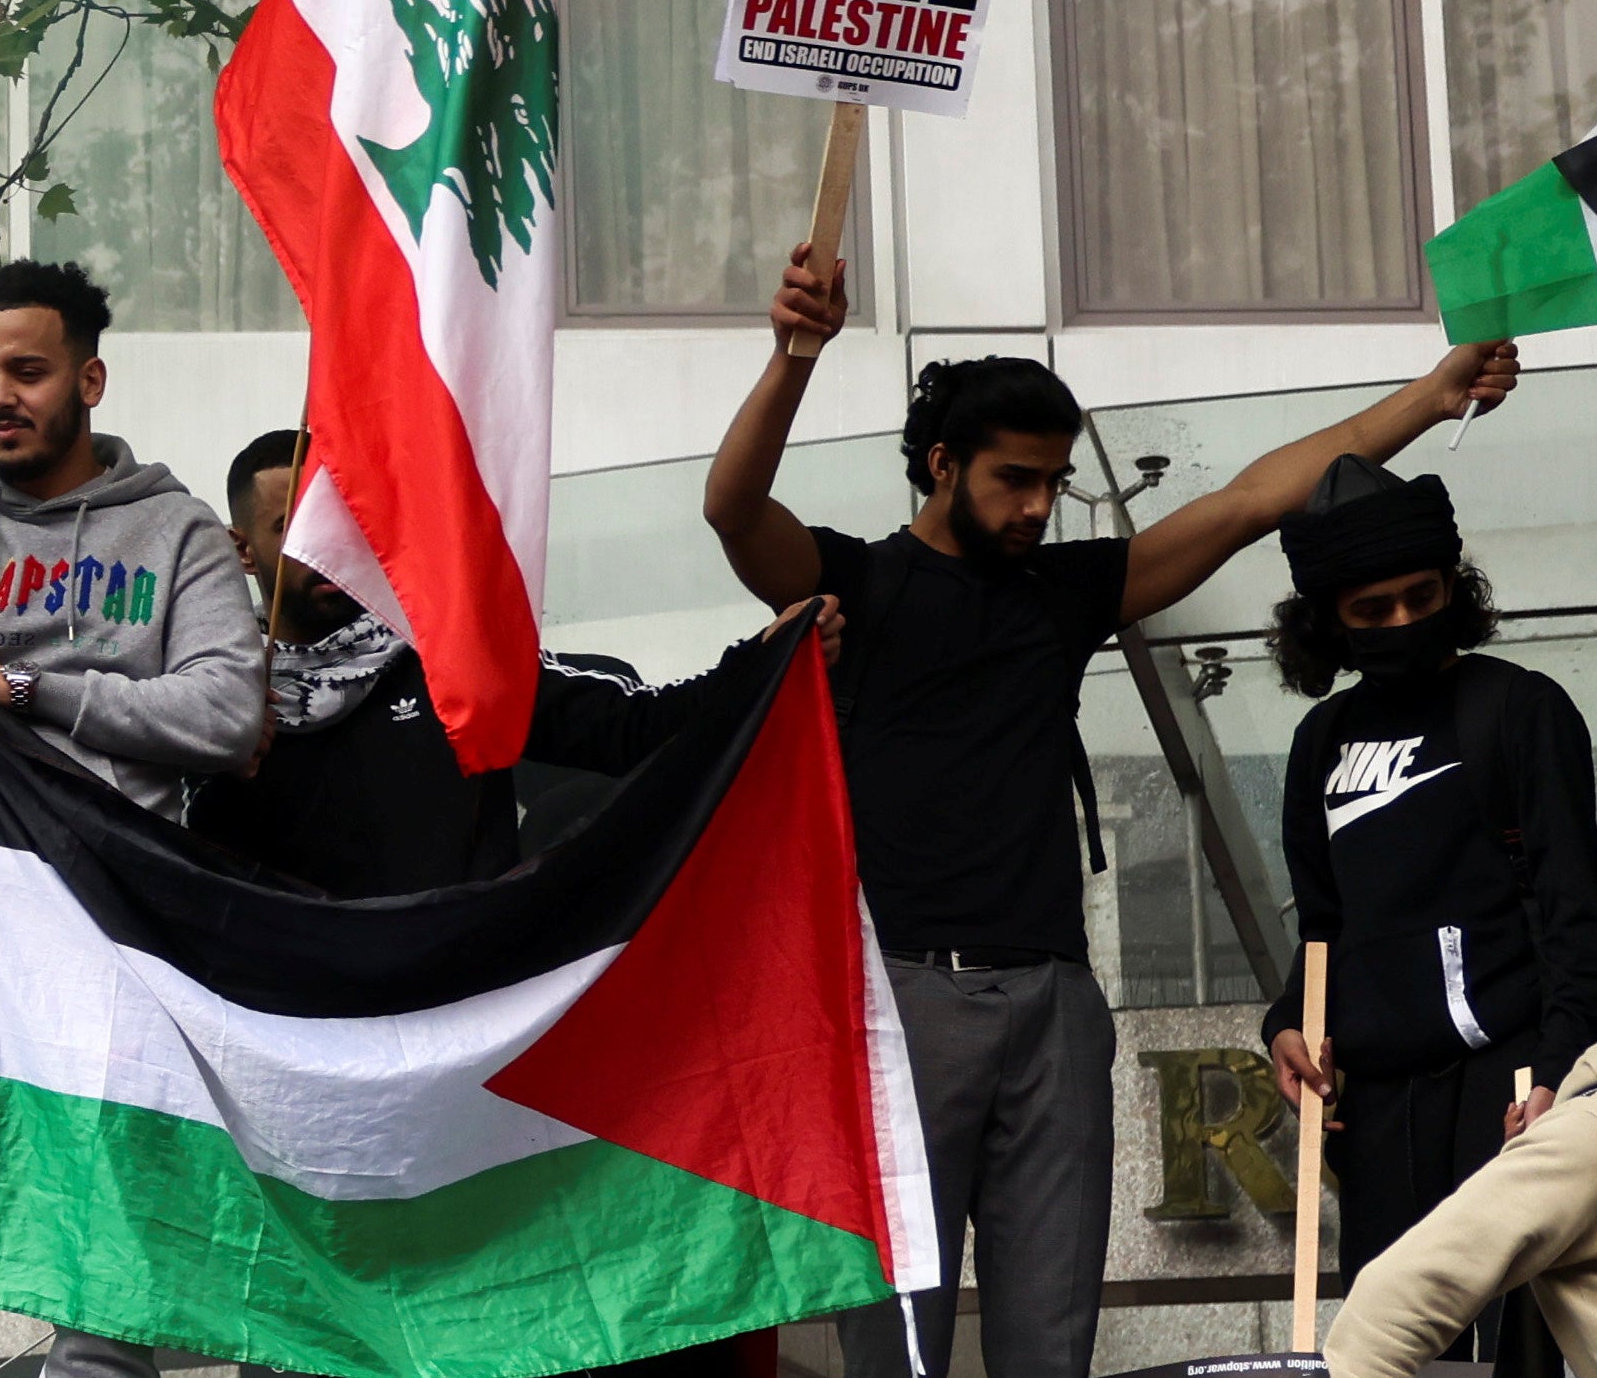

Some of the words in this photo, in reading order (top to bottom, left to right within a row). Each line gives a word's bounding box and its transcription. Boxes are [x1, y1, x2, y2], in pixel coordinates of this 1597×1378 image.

[744, 38, 773, 62] END
[778, 41, 845, 72] ISRAELI
[846, 52, 958, 88] OCCUPATION
[1326, 736, 1424, 795] NIKE
[1187, 1359, 1281, 1376] www.stopwar.org
